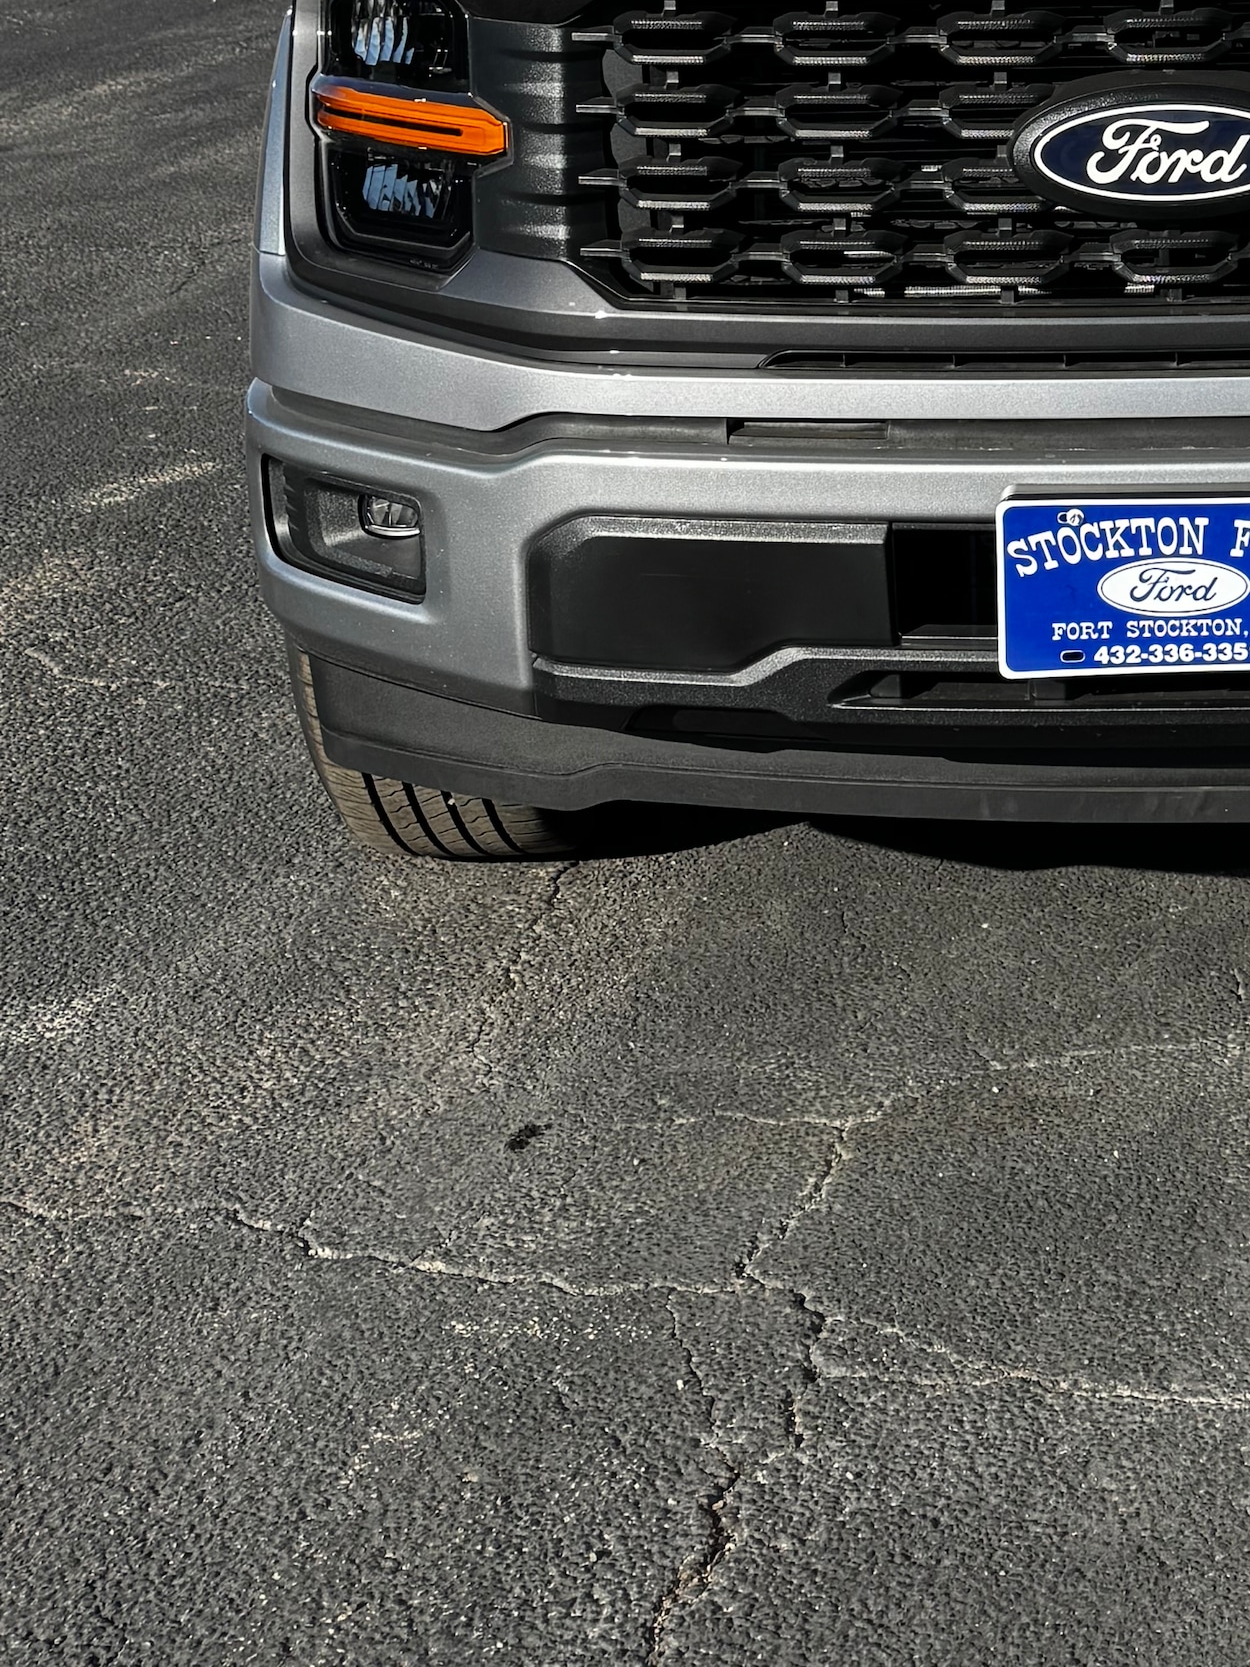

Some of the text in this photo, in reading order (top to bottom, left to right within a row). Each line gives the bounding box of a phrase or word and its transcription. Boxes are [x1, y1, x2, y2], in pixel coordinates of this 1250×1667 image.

[1086, 118, 1250, 184] Ford
[1007, 517, 1209, 578] STOCKTON
[1130, 567, 1218, 603] Ford
[1052, 621, 1113, 641] FORT
[1126, 618, 1249, 638] STOCKTON,
